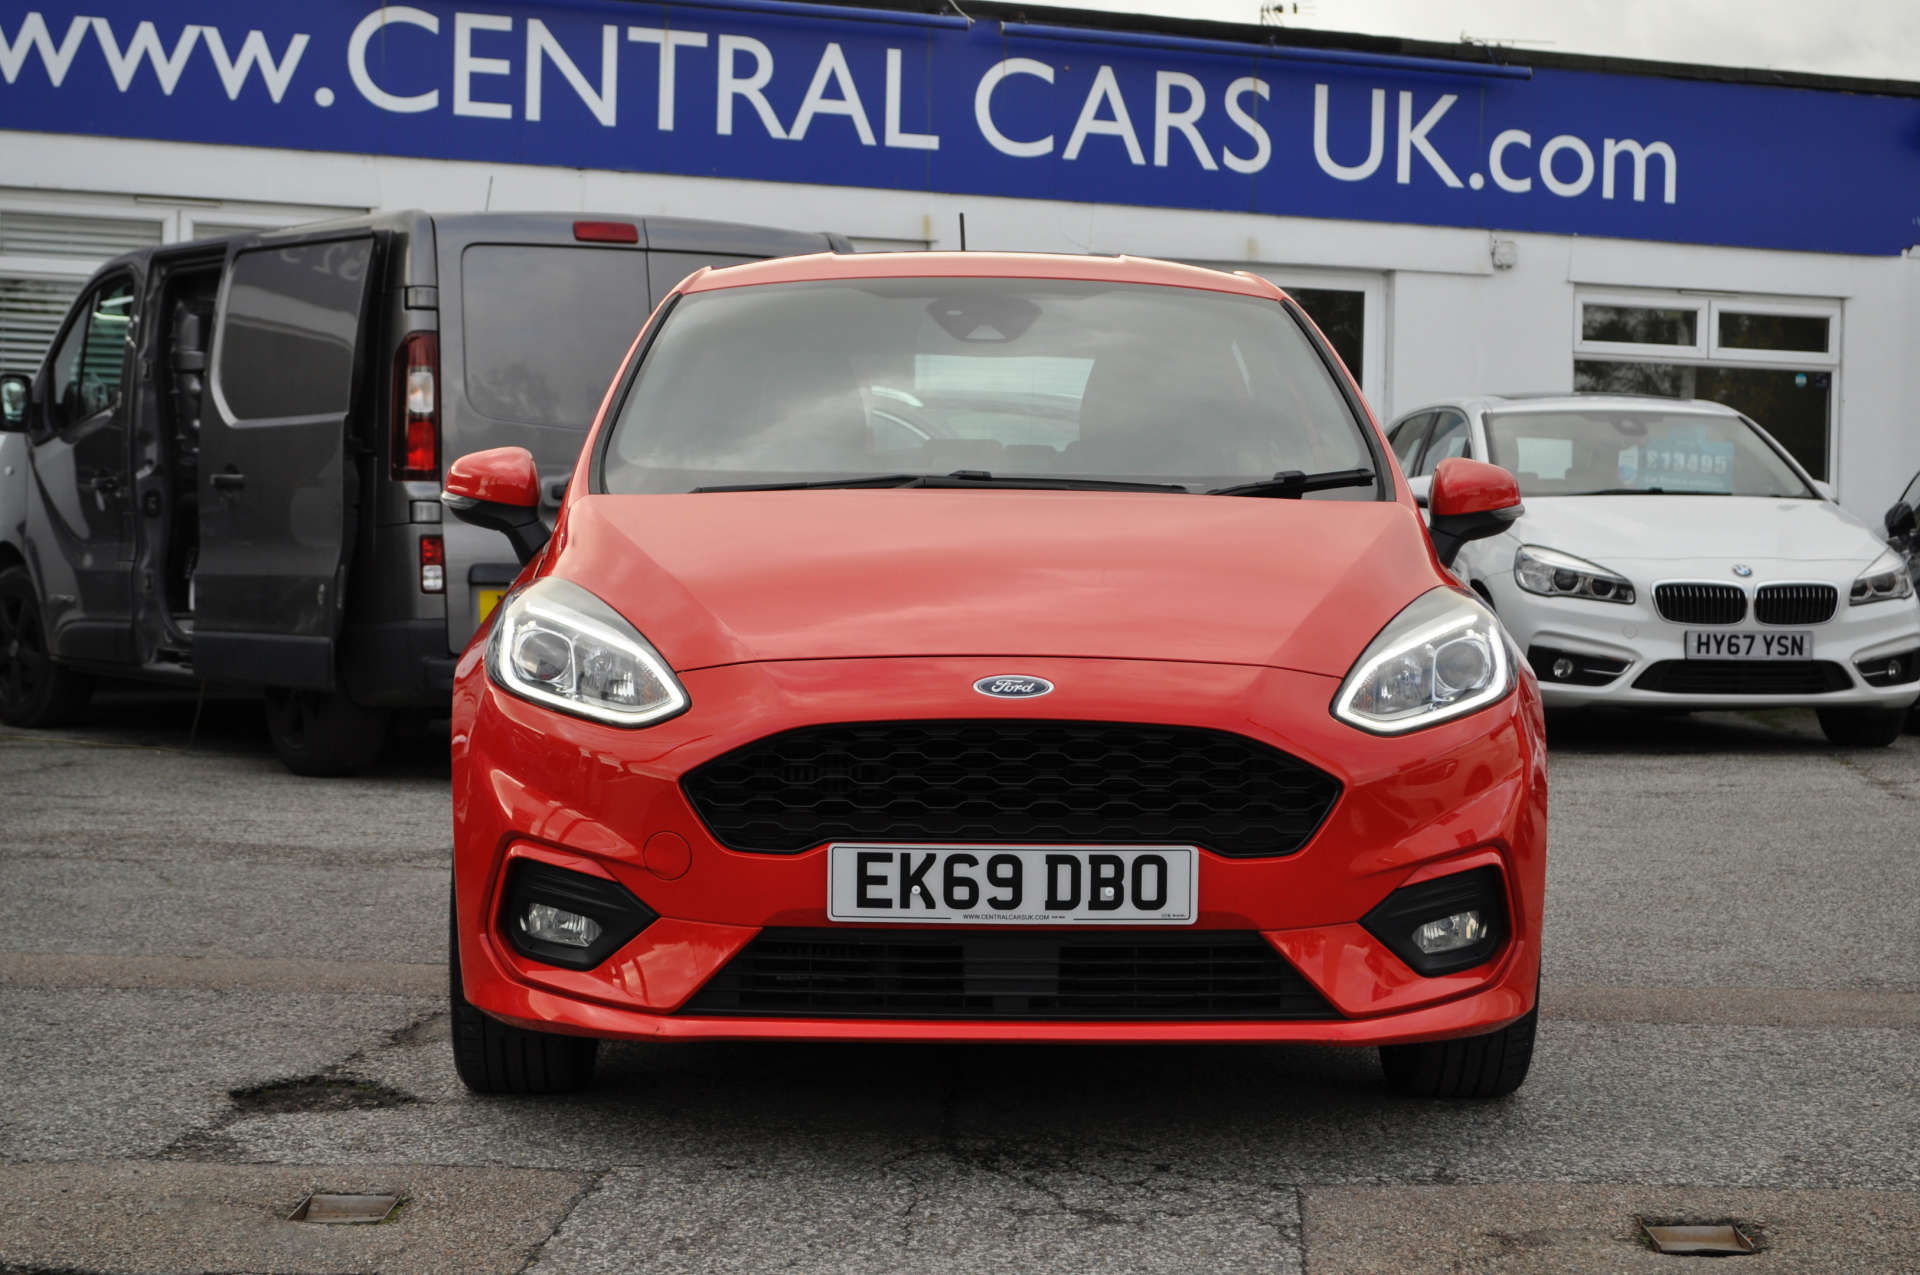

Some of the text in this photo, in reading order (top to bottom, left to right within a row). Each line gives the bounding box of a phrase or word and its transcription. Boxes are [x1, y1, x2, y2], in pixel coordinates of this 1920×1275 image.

[0, 7, 1676, 204] www.CENTRAL CARS UK.com
[1696, 633, 1804, 656] HY67 YSN
[991, 679, 1035, 693] Ford
[856, 851, 1168, 911] EK69 DBO
[962, 913, 1050, 921] WWW.CENTRALCARSUK.COM
